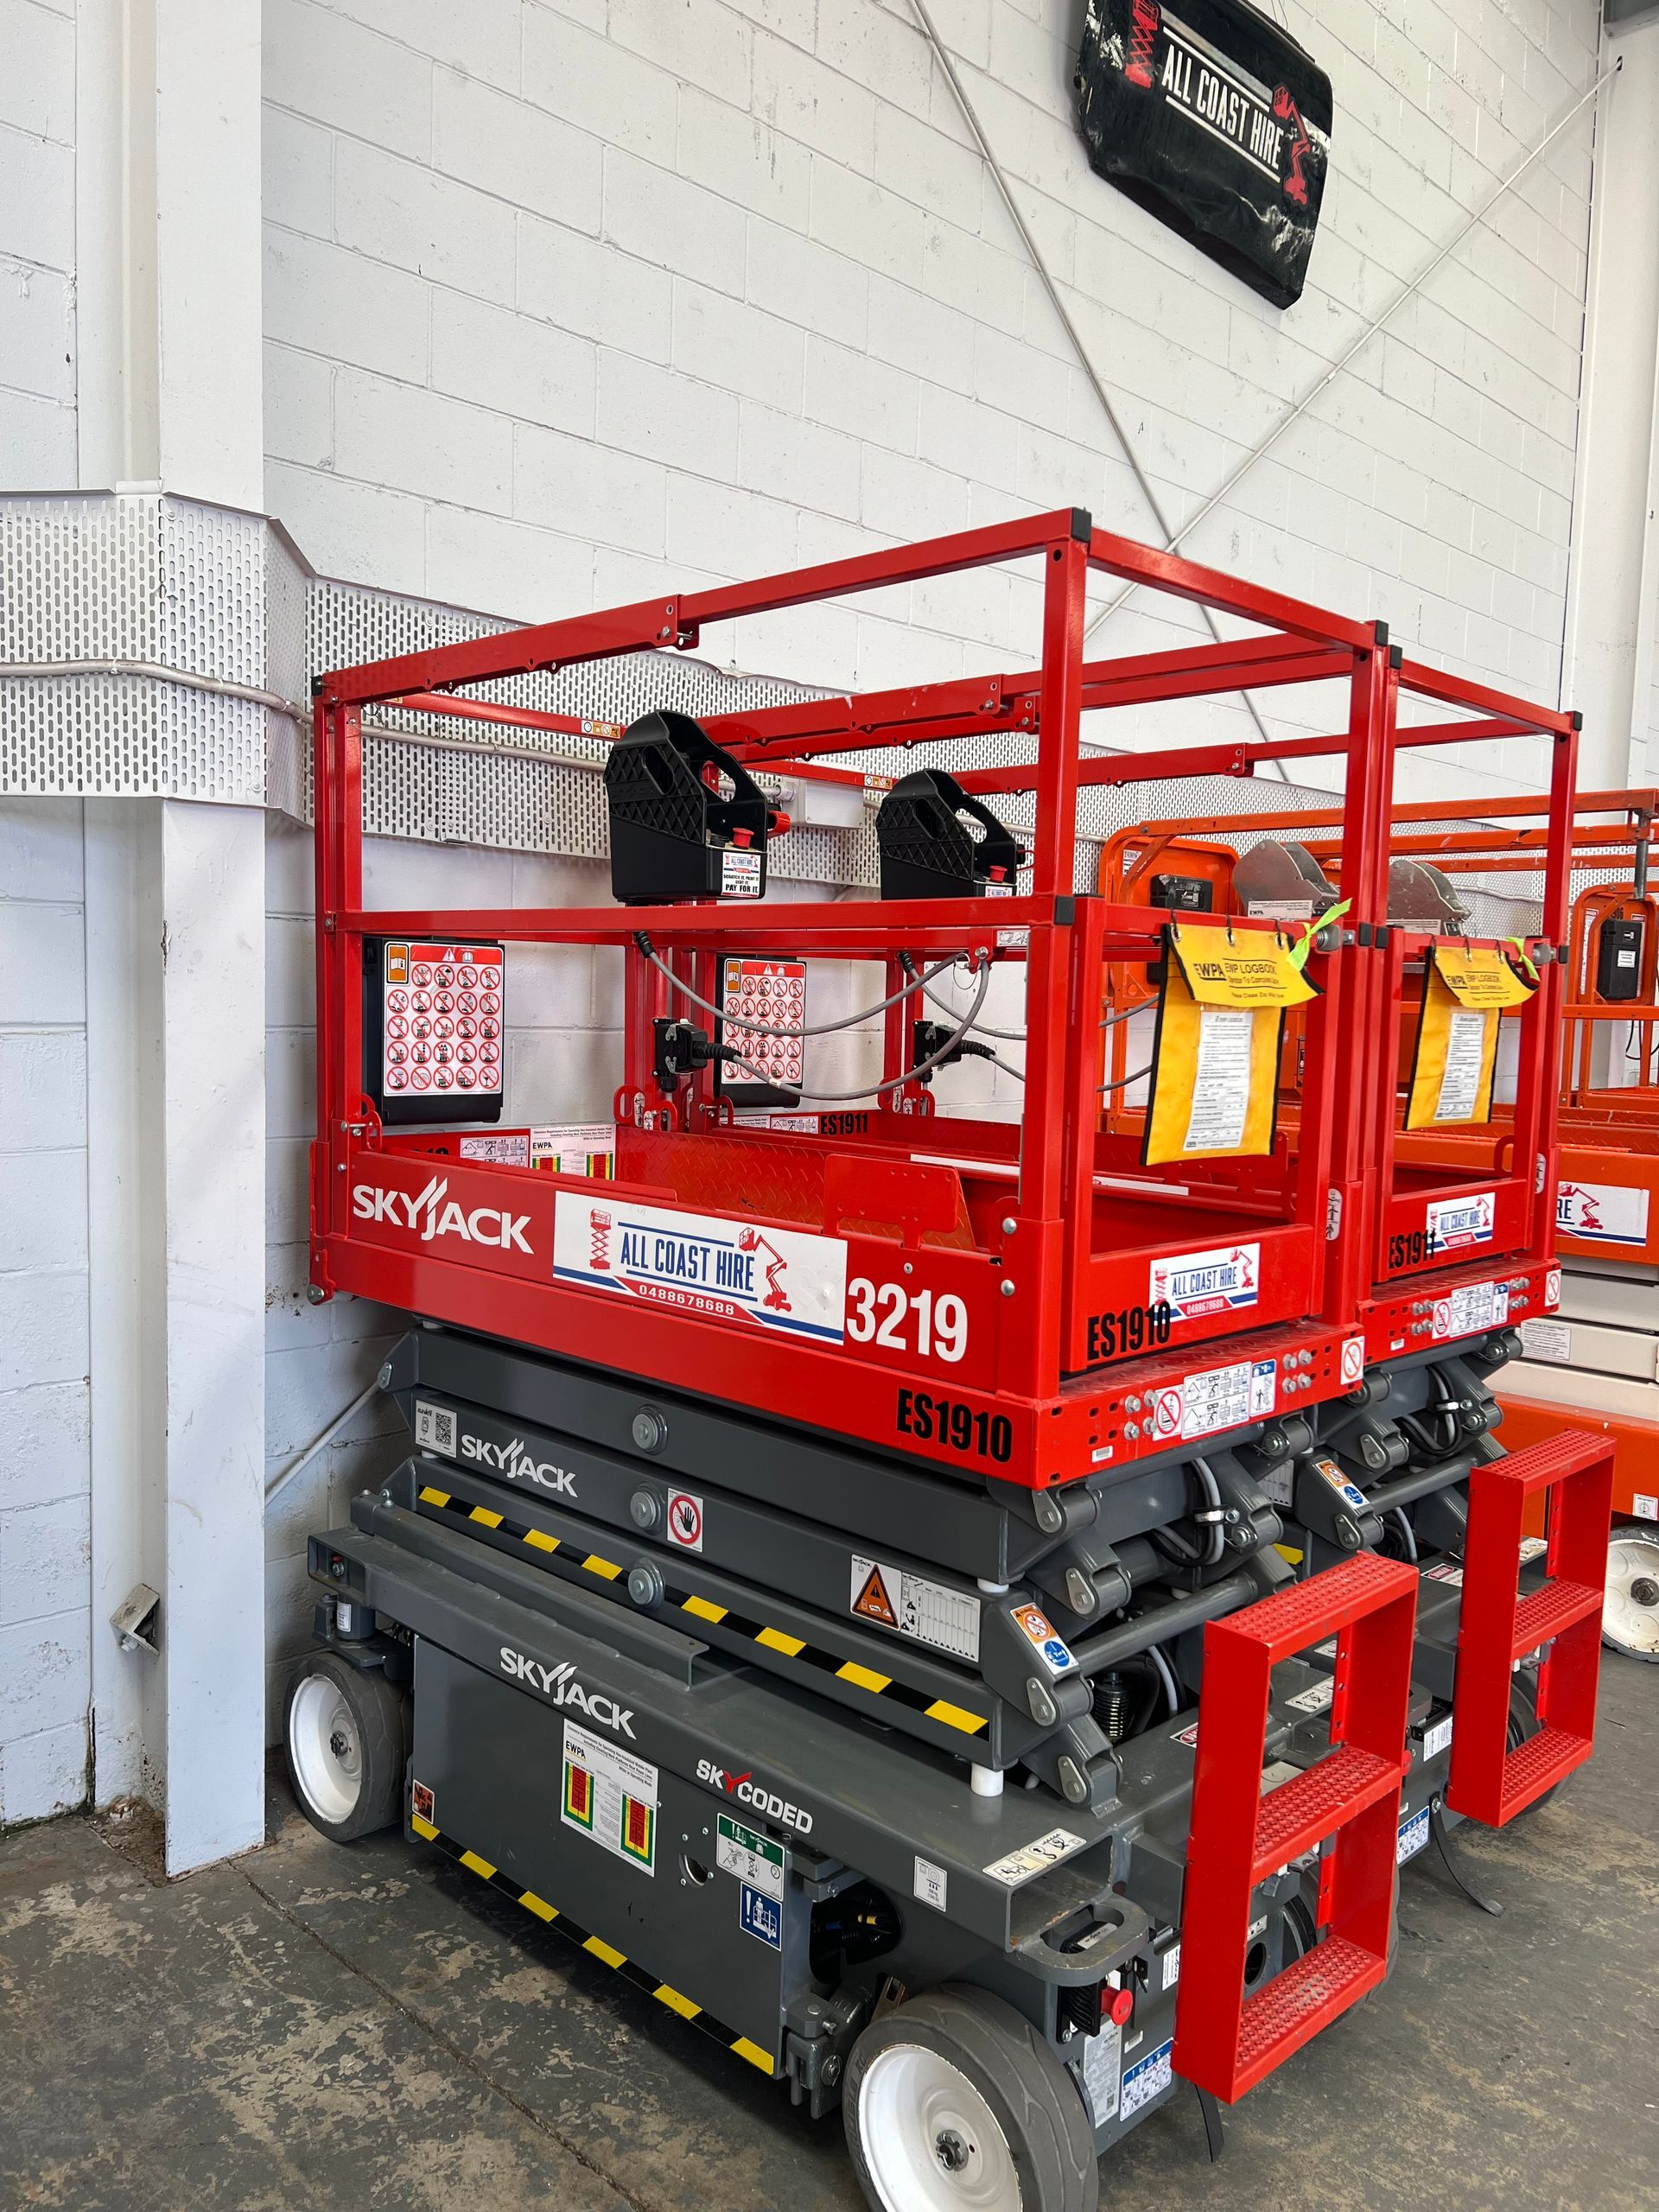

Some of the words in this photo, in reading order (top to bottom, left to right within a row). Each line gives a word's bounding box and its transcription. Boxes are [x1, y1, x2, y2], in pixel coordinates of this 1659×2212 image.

[1161, 44, 1192, 105] ALL
[1197, 68, 1249, 142] COAST
[1250, 111, 1284, 170] HIRE
[1193, 963, 1226, 977] EWPA
[1240, 963, 1277, 976] LOGBOOK
[821, 1112, 868, 1135] ES1911
[353, 1174, 535, 1255] SKYJACK
[1557, 1198, 1573, 1220] RE
[620, 1232, 648, 1269] ALL
[654, 1238, 710, 1281] COAST
[715, 1249, 754, 1292] HIRE
[1389, 1228, 1436, 1269] ES1911
[639, 1284, 734, 1316] 0488678688
[1172, 1274, 1187, 1296] ALL
[1190, 1270, 1217, 1293] COAST
[1219, 1266, 1237, 1287] HIRE
[847, 1277, 968, 1363] 3219
[1087, 1300, 1171, 1361] ES1910
[897, 1387, 1013, 1463] ES1910
[461, 1437, 578, 1498] SKYJACK
[499, 1647, 638, 1740] SKYJACK
[566, 1740, 586, 1759] EWPA
[696, 1758, 814, 1834] SKYCODED
